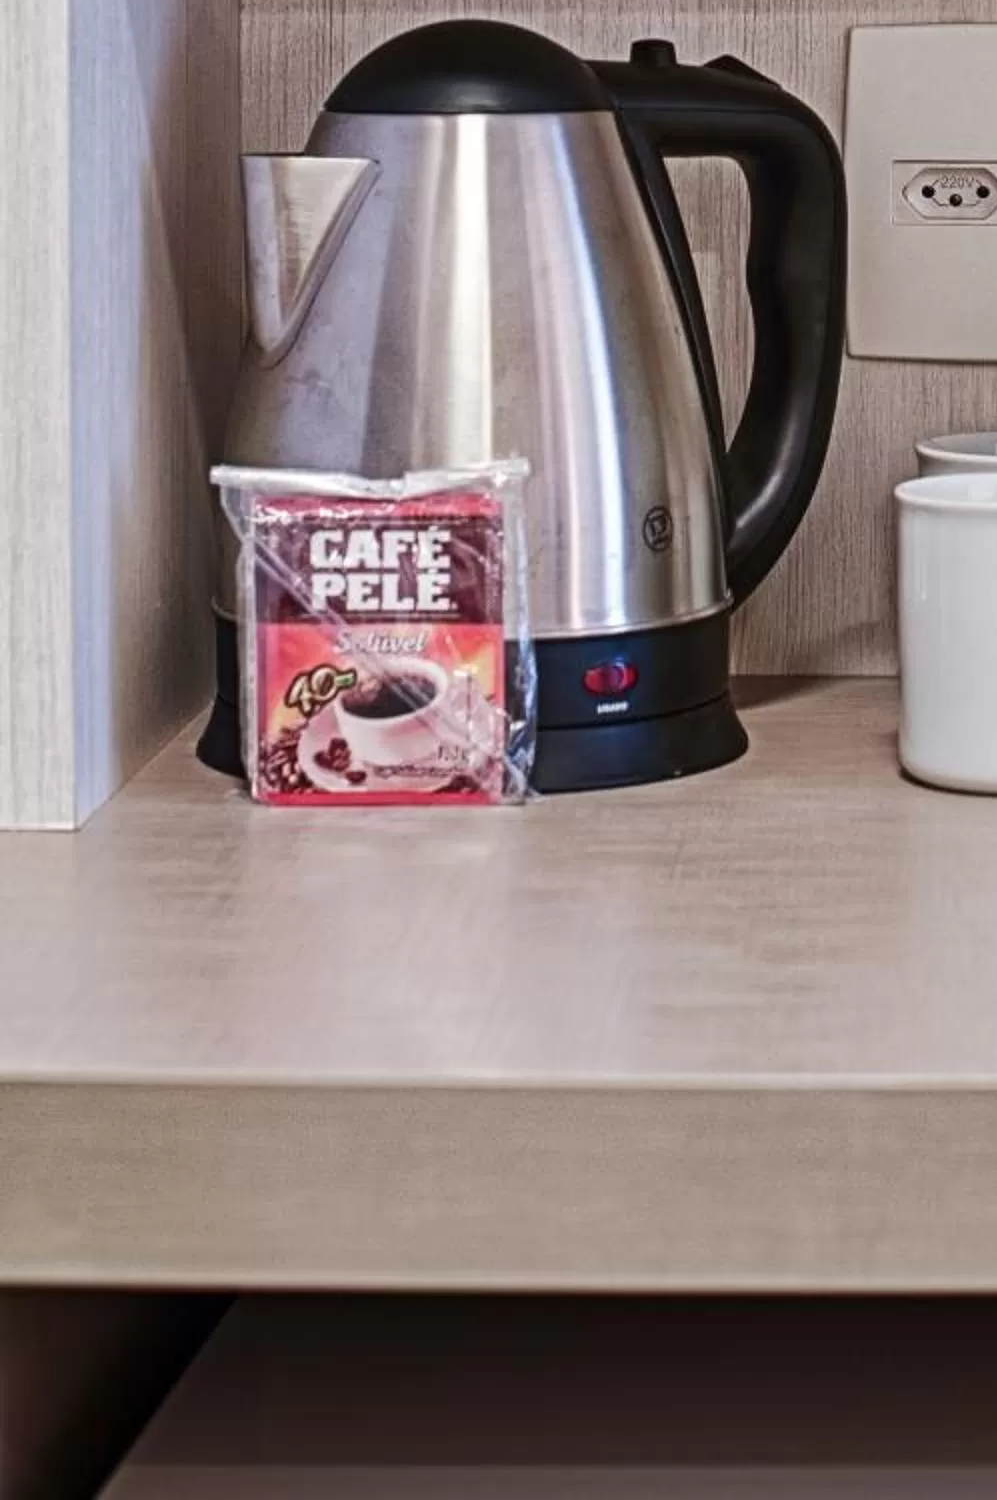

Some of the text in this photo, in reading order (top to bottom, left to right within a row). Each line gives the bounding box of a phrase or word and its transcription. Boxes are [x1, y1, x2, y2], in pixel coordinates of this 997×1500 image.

[940, 176, 975, 190] 220V
[309, 525, 451, 569] CAFÉ
[310, 569, 451, 611] PELÉ
